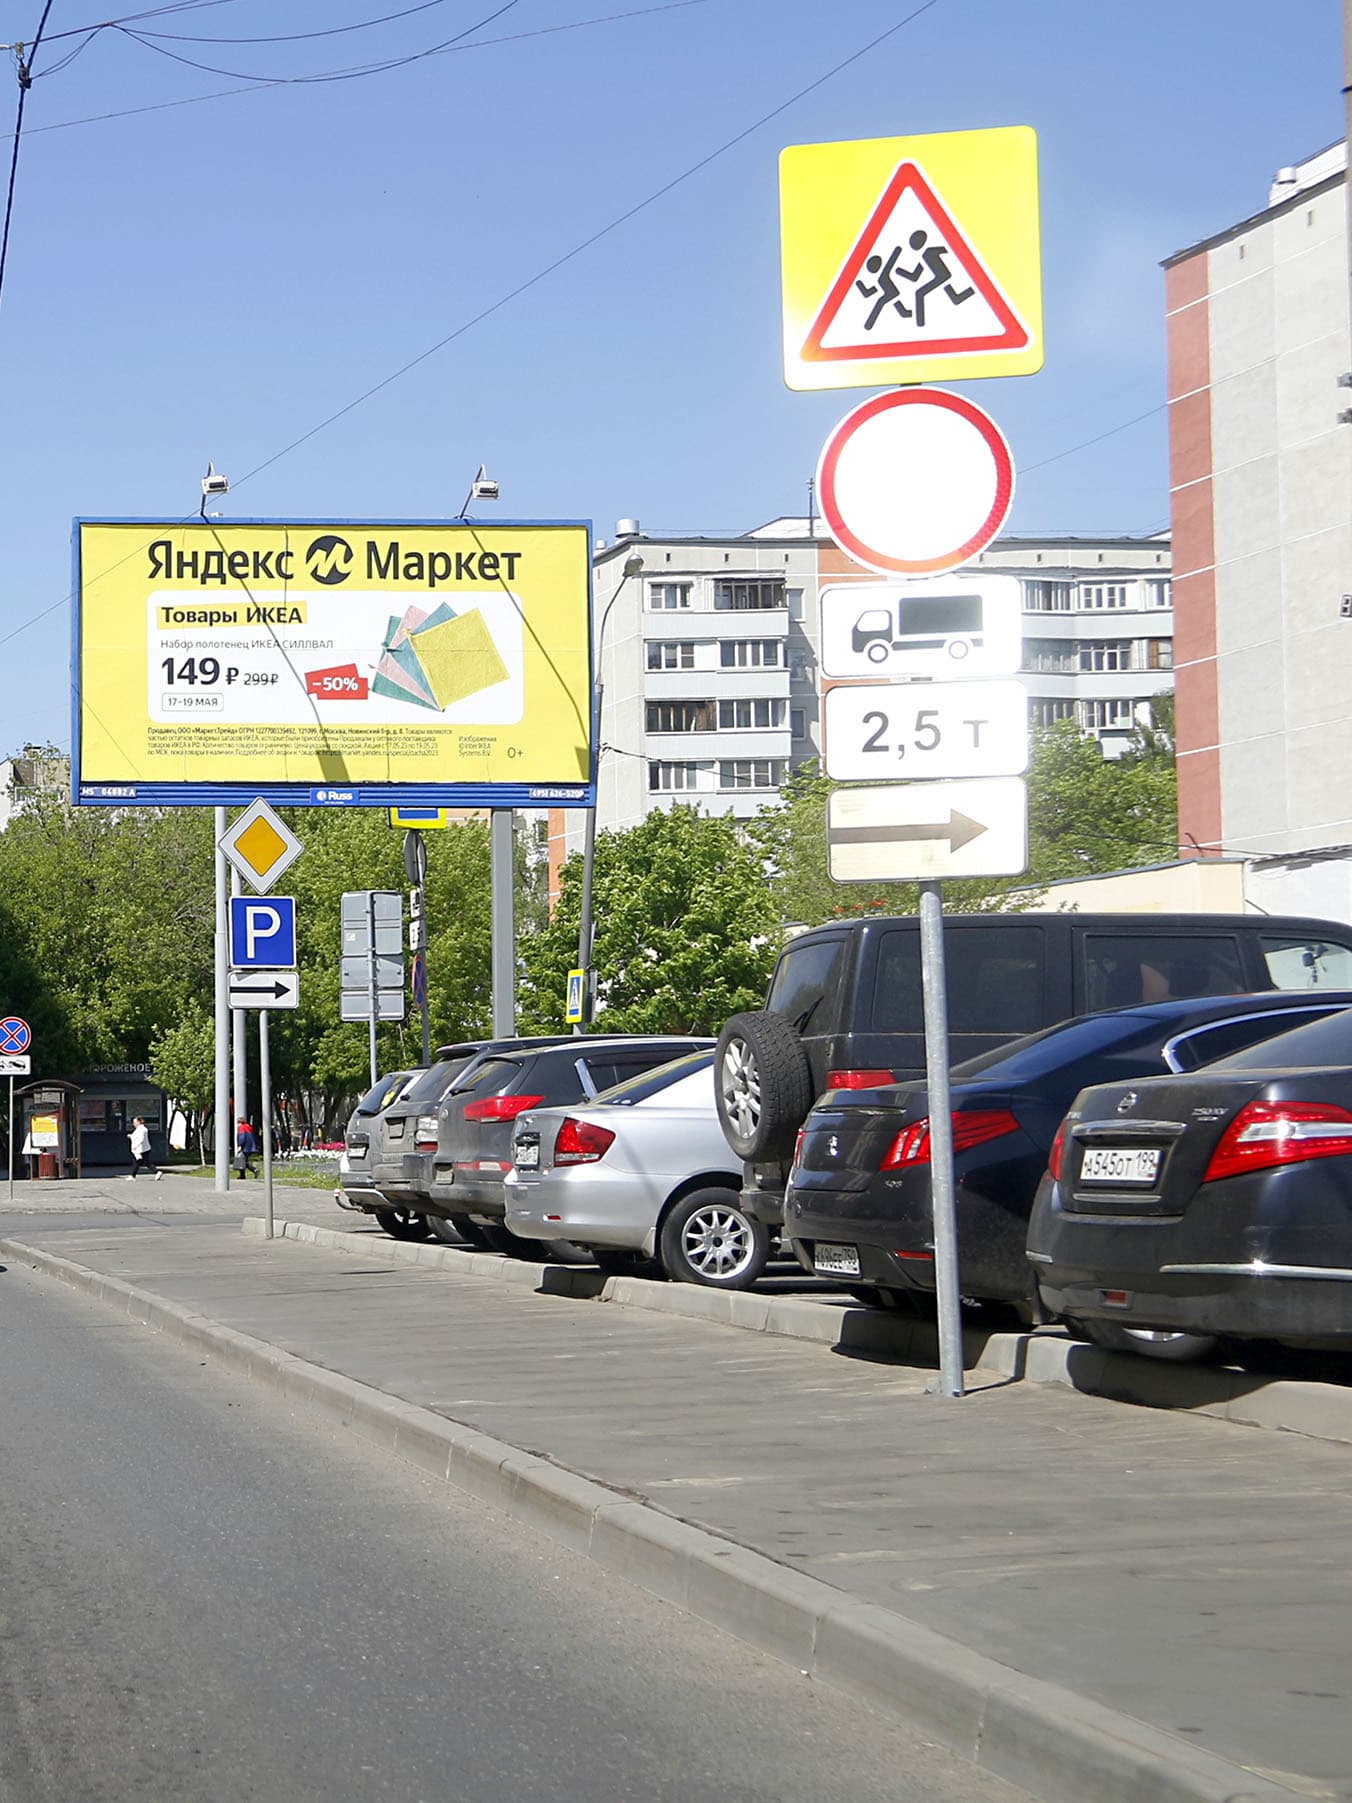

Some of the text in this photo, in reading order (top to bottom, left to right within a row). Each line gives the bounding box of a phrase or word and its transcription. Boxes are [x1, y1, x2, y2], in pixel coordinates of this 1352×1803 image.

[148, 540, 294, 585] Яндекс
[366, 541, 522, 588] Маркет
[161, 606, 303, 626] Товары ИКЕА
[160, 639, 334, 651] Набор полотенец ИКЕА СИЛЛВАЛ
[161, 656, 221, 686] 149
[194, 697, 219, 707] МАЯ
[861, 709, 942, 761] 2,5
[506, 746, 524, 759] 0+
[327, 790, 354, 801] Russ
[245, 905, 282, 959] P
[1135, 1151, 1156, 1170] 199
